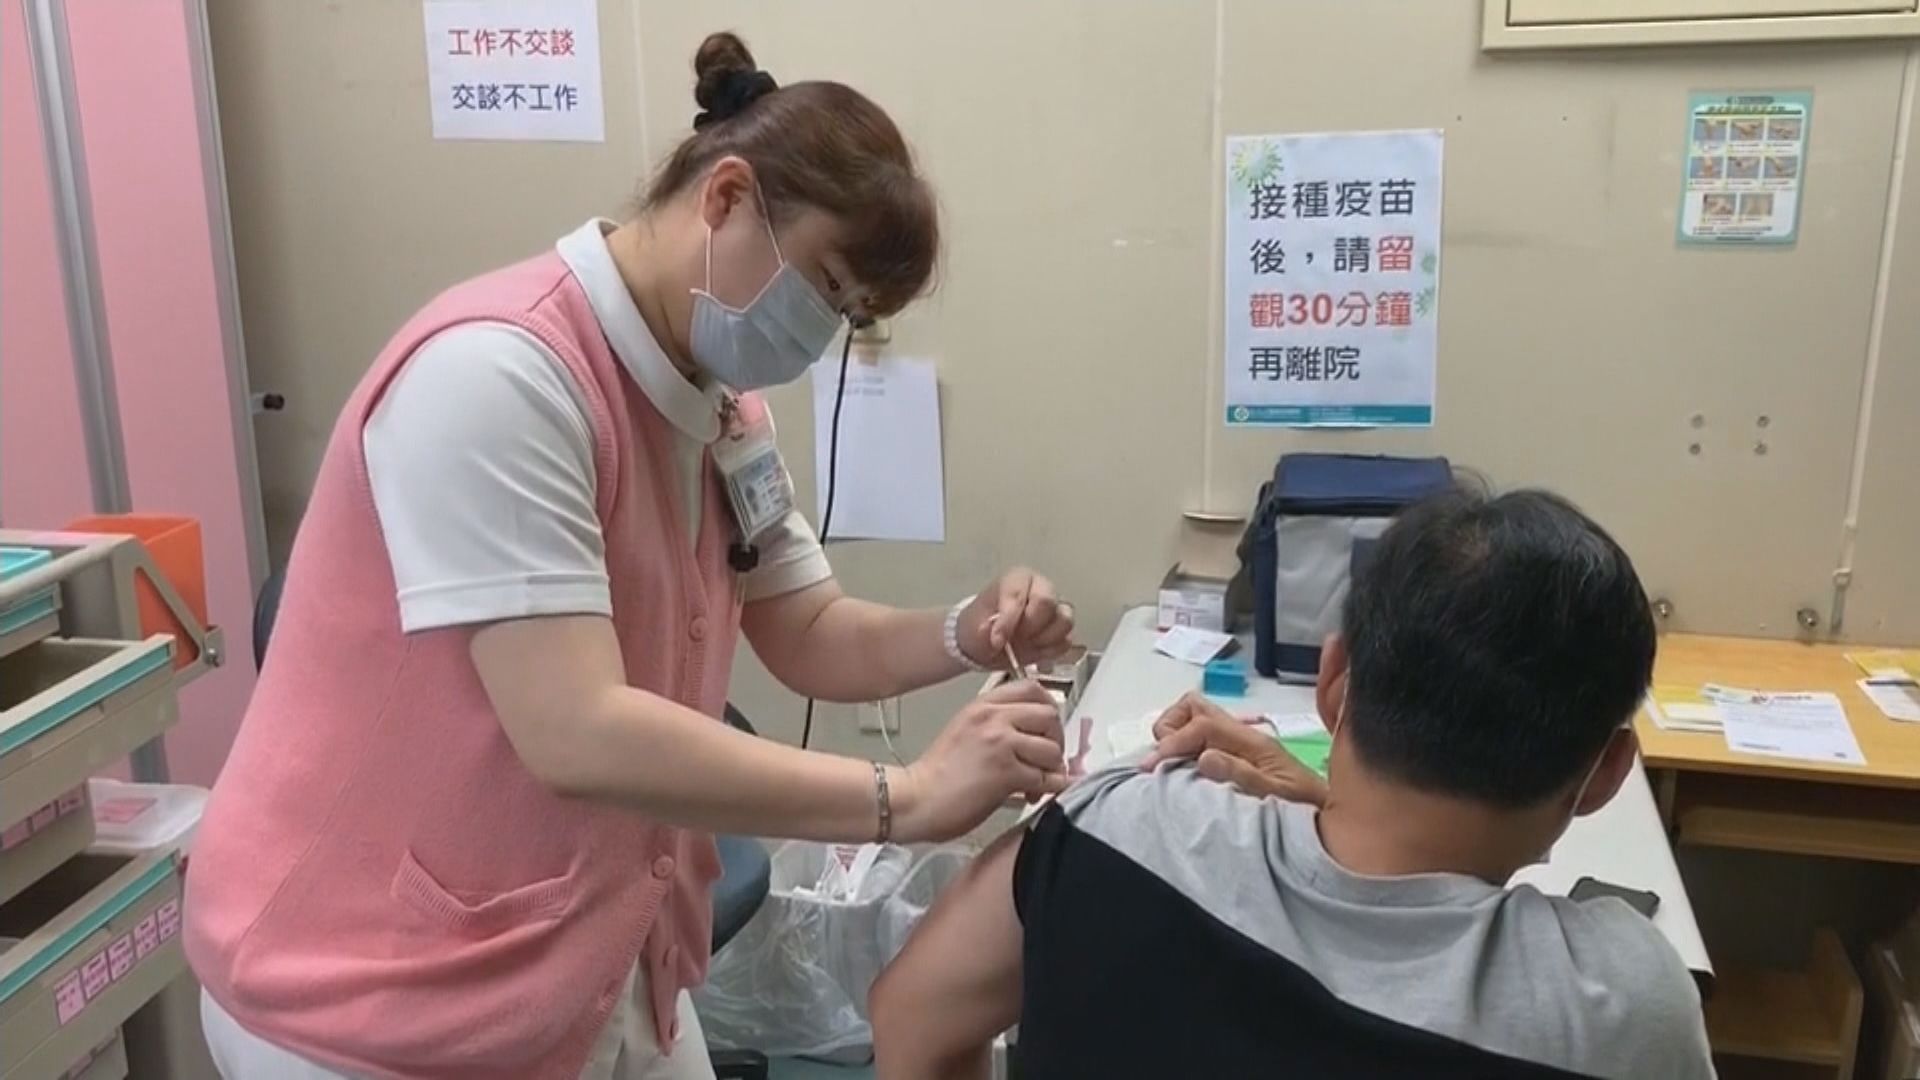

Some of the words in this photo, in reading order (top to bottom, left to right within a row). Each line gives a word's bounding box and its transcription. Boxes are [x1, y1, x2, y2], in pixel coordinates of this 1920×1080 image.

[448, 28, 575, 56] 工作不交談
[452, 83, 577, 110] 交談不工作
[1249, 178, 1415, 219] 接種疫苗
[1250, 291, 1412, 328] 觀30分鐘
[1248, 346, 1360, 381] 再離院
